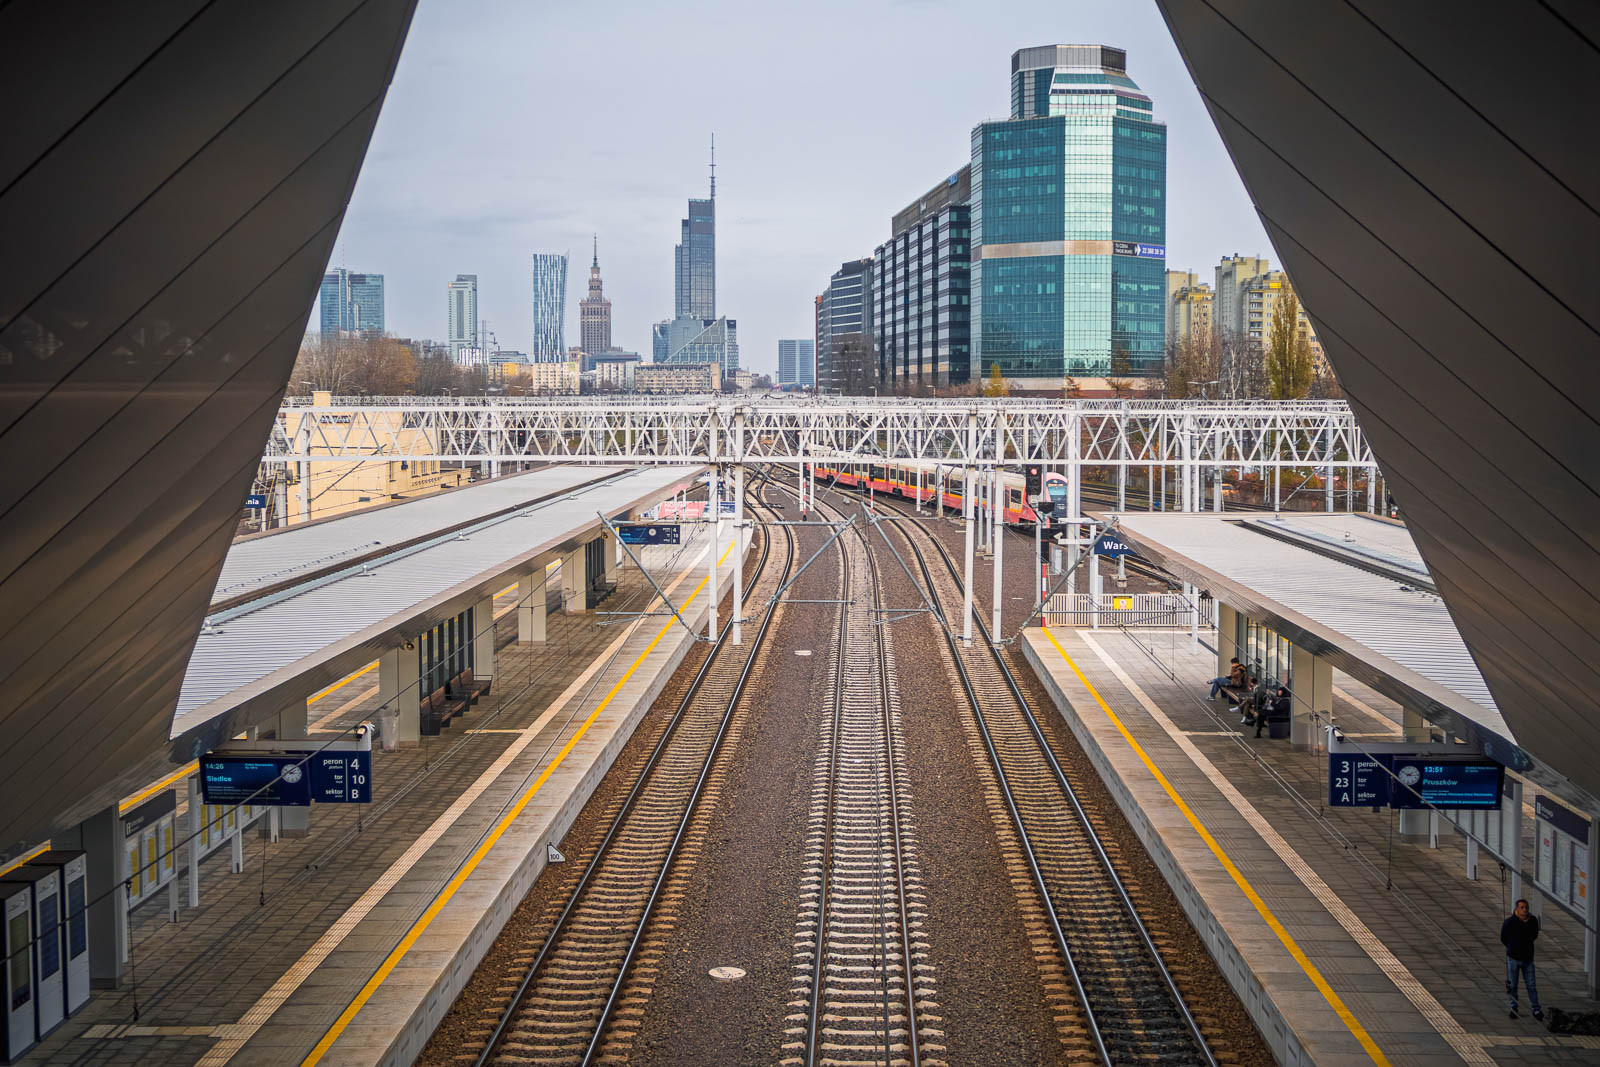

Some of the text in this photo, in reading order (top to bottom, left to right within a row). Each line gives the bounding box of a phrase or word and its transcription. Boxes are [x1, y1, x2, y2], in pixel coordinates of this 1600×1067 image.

[1104, 541, 1128, 549] Wars
[350, 758, 360, 770] 4
[1341, 761, 1350, 773] 3
[352, 775, 365, 784] 10
[1335, 778, 1349, 788] 23
[352, 789, 359, 799] B
[1341, 792, 1350, 802] A
